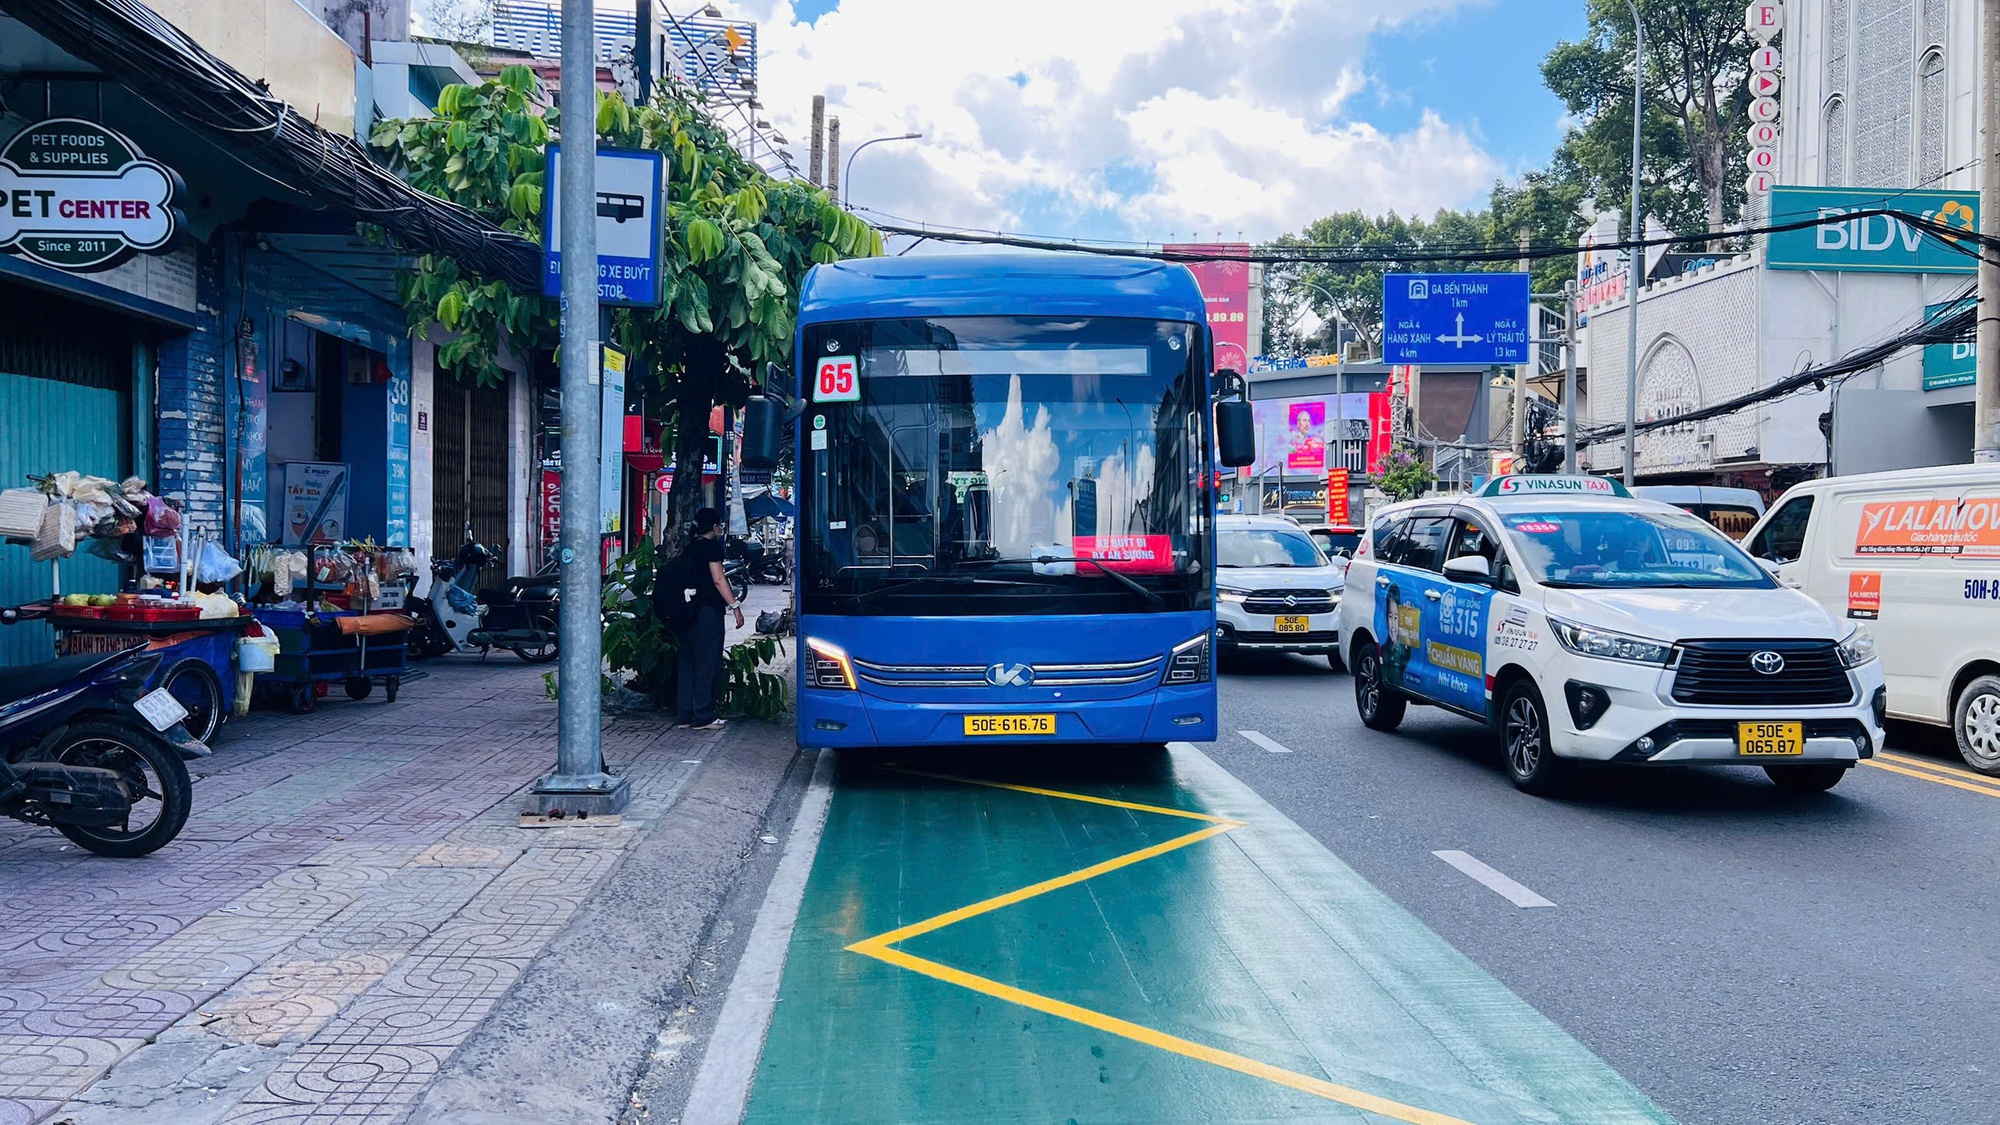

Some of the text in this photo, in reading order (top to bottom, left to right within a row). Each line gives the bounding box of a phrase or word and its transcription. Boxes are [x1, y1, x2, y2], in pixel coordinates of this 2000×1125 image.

[32, 135, 105, 147] PET FOODS
[29, 152, 109, 165] & SUPPLIES
[59, 199, 151, 220] CENTER
[1816, 205, 1936, 252] BIDV
[38, 240, 106, 253] Since 2011
[609, 265, 622, 279] XE
[624, 262, 651, 281] BUÝT
[598, 283, 624, 298] STOP
[1431, 280, 1489, 295] GA BẾN THÀNH
[1456, 297, 1468, 308] km
[1415, 320, 1421, 329] 4
[1511, 320, 1517, 329] 6
[1387, 330, 1432, 344] HÀNG XANH
[1486, 329, 1497, 343] LÝ
[1497, 329, 1514, 343] THÁI
[1399, 347, 1418, 358] 4 km
[1505, 347, 1517, 358] km
[820, 363, 853, 395] 65
[391, 377, 409, 407] 38
[1525, 479, 1610, 491] VINASUN TAXI
[1098, 538, 1109, 548] XE
[1910, 531, 1928, 543] Giao
[1962, 529, 1979, 543] tốc
[1108, 550, 1121, 560] AN
[1849, 591, 1879, 599] LALAMOVE
[1466, 598, 1482, 610] ĐỒNG
[1284, 616, 1299, 624] 50E
[1454, 607, 1480, 639] 315
[1510, 637, 1519, 648] 27
[1519, 638, 1529, 649] 27
[1528, 640, 1539, 651] 27
[1457, 652, 1481, 675] VÀNG
[1437, 671, 1450, 688] Nhi
[1451, 676, 1469, 694] khoa
[972, 718, 1048, 732] 50E-616.76
[1757, 724, 1785, 738] 50E
[1746, 739, 1796, 754] 065.87
